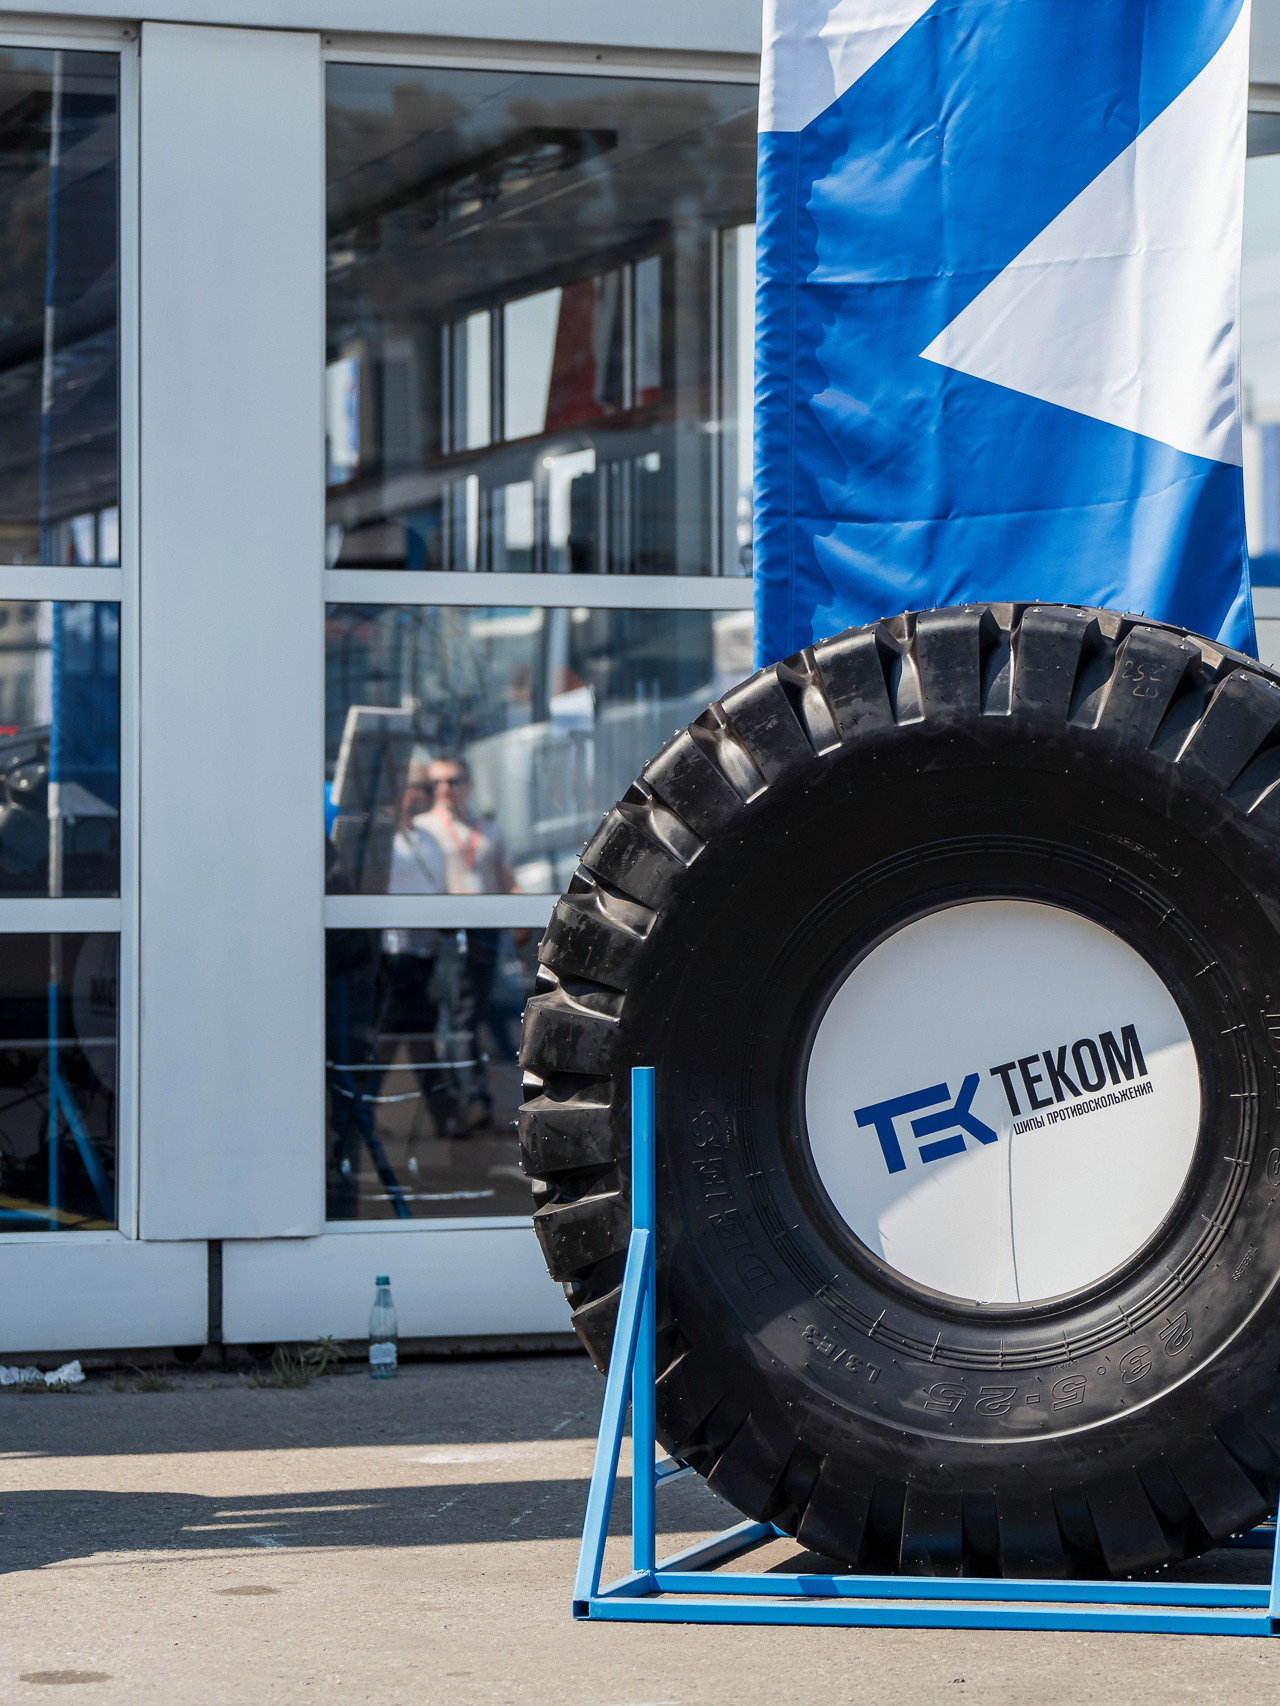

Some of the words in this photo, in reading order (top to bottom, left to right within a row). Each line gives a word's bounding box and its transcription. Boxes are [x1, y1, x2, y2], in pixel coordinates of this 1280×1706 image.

[853, 1072, 998, 1174] ТЕК
[989, 1023, 1148, 1117] ТЕКОМ
[1013, 1115, 1046, 1135] ШИПЫ
[1047, 1081, 1154, 1125] ПРОТИВОСКОЛЬЖЕНИЯ
[801, 1324, 882, 1384] L3/E3
[923, 1311, 1194, 1417] 23.5-25
